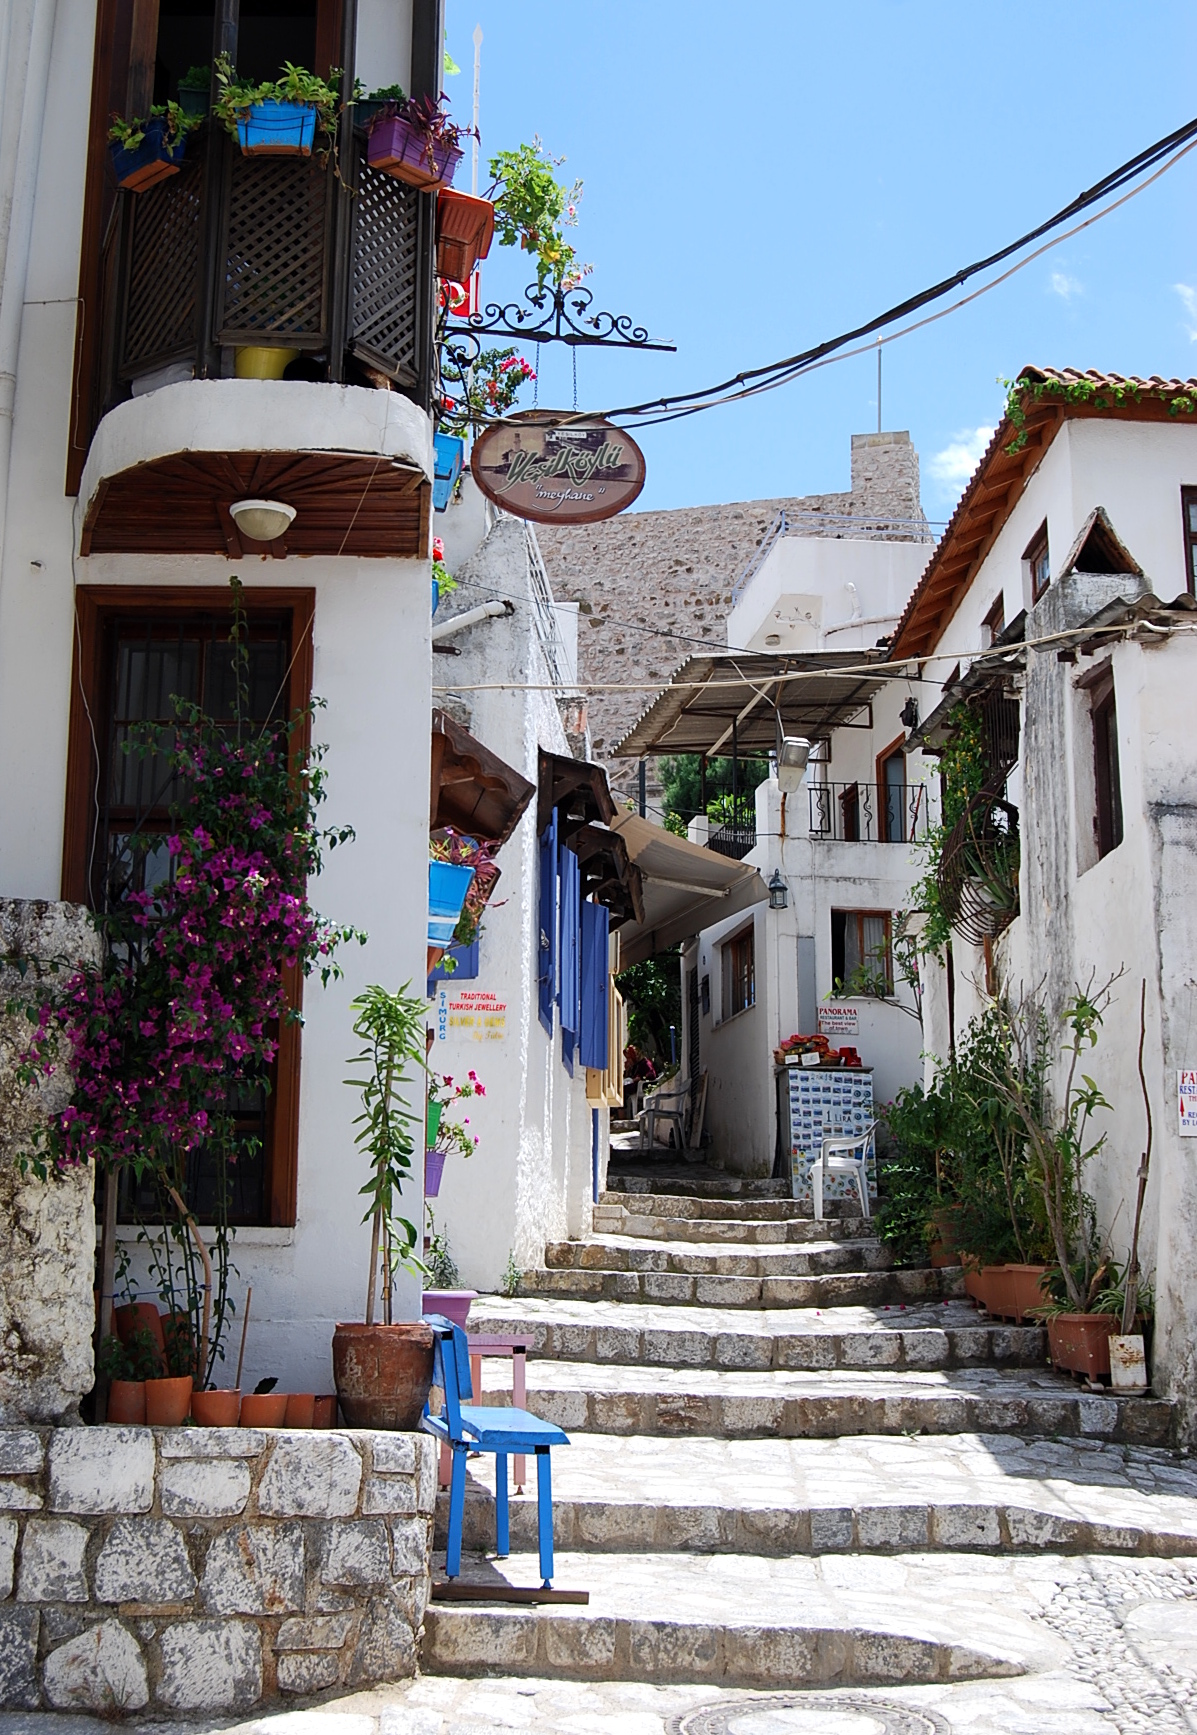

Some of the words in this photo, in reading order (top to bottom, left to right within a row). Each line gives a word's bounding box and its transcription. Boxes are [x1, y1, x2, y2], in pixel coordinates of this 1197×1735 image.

[460, 992, 497, 1001] TRADITIONAL
[448, 1002, 473, 1011] TURKISH
[474, 1003, 507, 1012] JEWELLERY
[819, 1007, 858, 1016] PANORAMA
[449, 1016, 475, 1027] SILVER
[1181, 1071, 1197, 1085] PA
[1180, 1086, 1197, 1095] REST
[826, 1110, 832, 1123] 1
